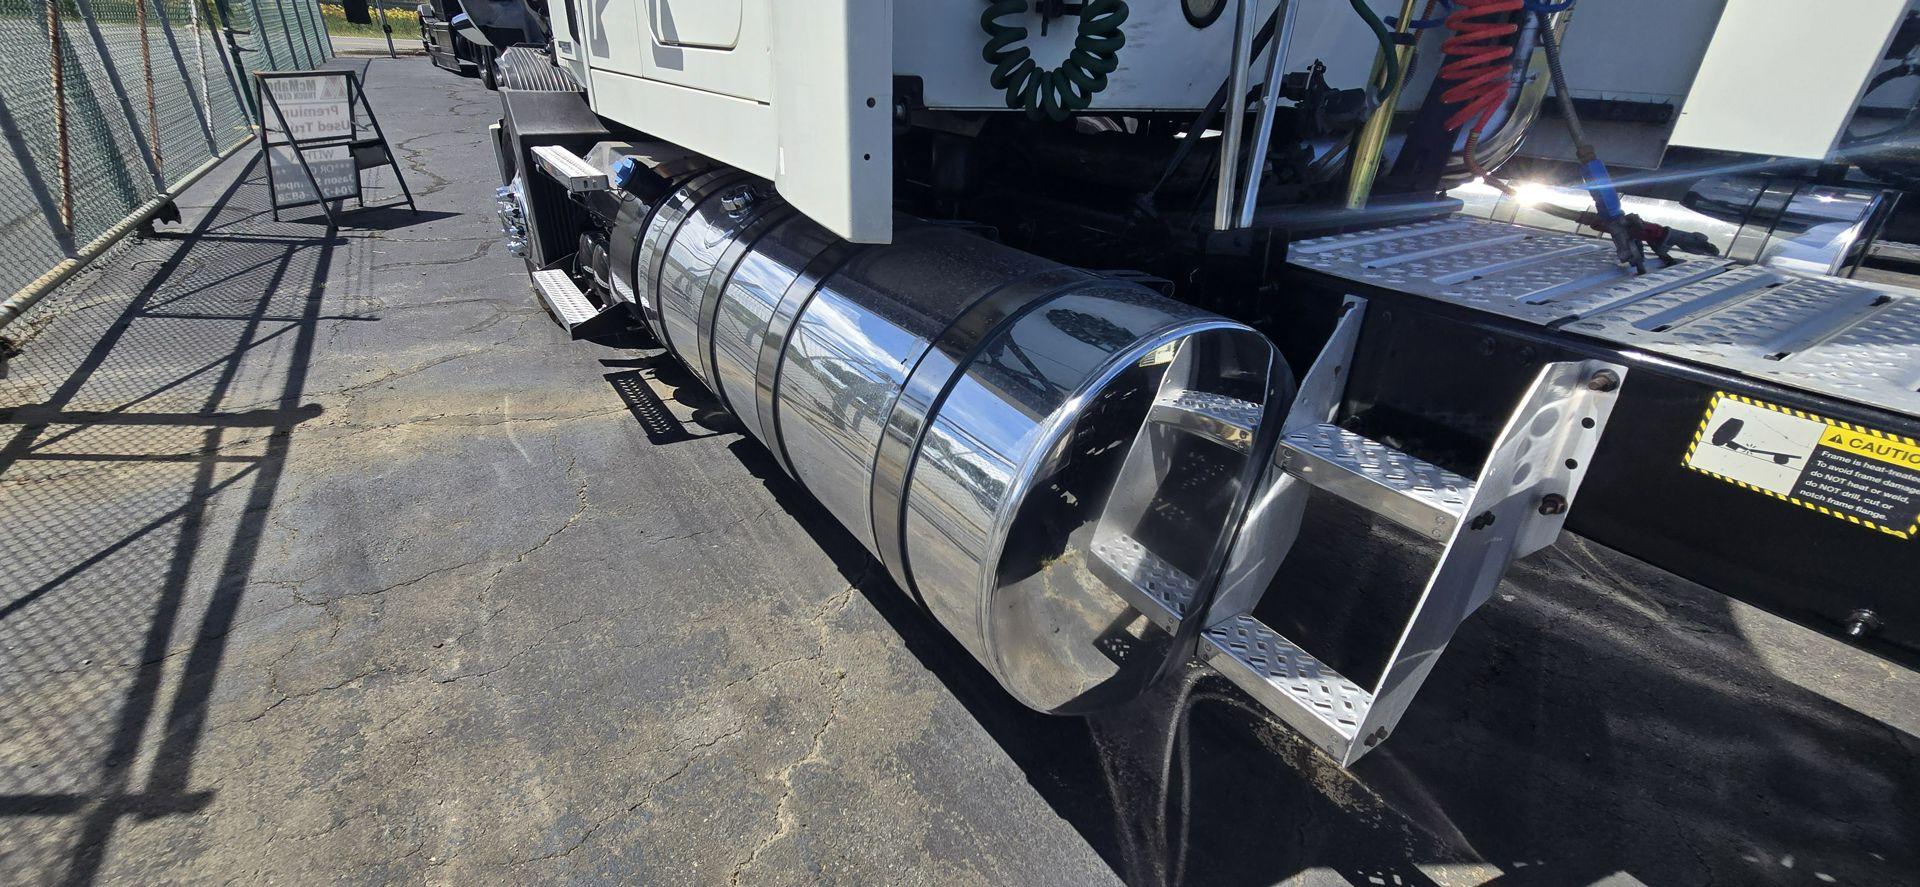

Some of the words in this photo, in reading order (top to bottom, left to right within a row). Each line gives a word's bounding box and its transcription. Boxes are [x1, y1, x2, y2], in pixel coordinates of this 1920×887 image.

[1822, 450, 1851, 464] Frame
[1853, 459, 1861, 467] is
[1849, 438, 1920, 463] CAUTIO
[1817, 460, 1827, 468] To
[1828, 465, 1853, 475] avoid
[1855, 471, 1881, 483] frame
[1818, 484, 1841, 493] NOT
[1841, 491, 1861, 501] drill,
[1863, 498, 1881, 506] cut
[1824, 474, 1847, 484] NOT
[1847, 481, 1869, 491] heat
[1883, 492, 1909, 504] weld,
[1799, 490, 1826, 501] notch
[1827, 497, 1854, 509] frame
[1855, 505, 1888, 520] flange.
